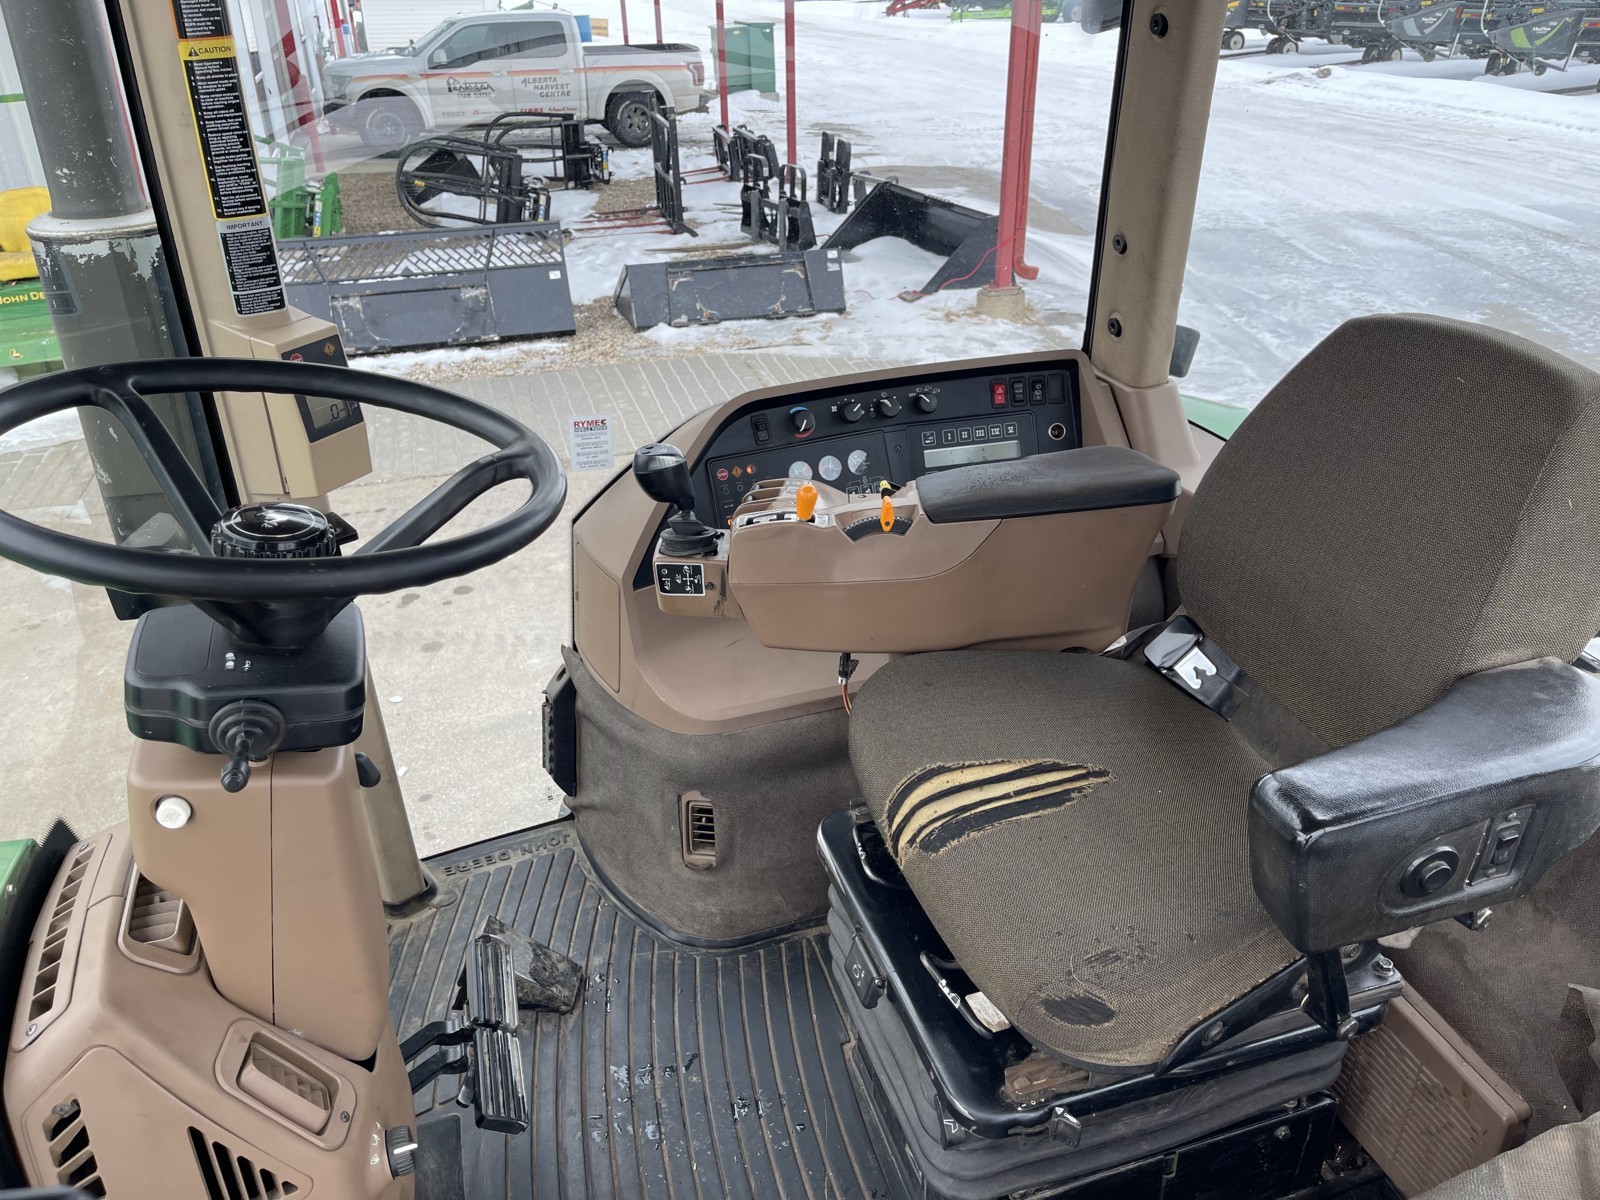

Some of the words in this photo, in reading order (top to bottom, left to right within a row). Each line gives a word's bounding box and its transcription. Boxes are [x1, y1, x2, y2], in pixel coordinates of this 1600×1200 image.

[198, 46, 231, 54] CAUTION
[522, 76, 558, 88] ALBERTA
[226, 221, 263, 230] IMPORTANT
[574, 419, 607, 428] RYMEC
[520, 834, 570, 855] JOHN
[444, 849, 511, 876] DEERE
